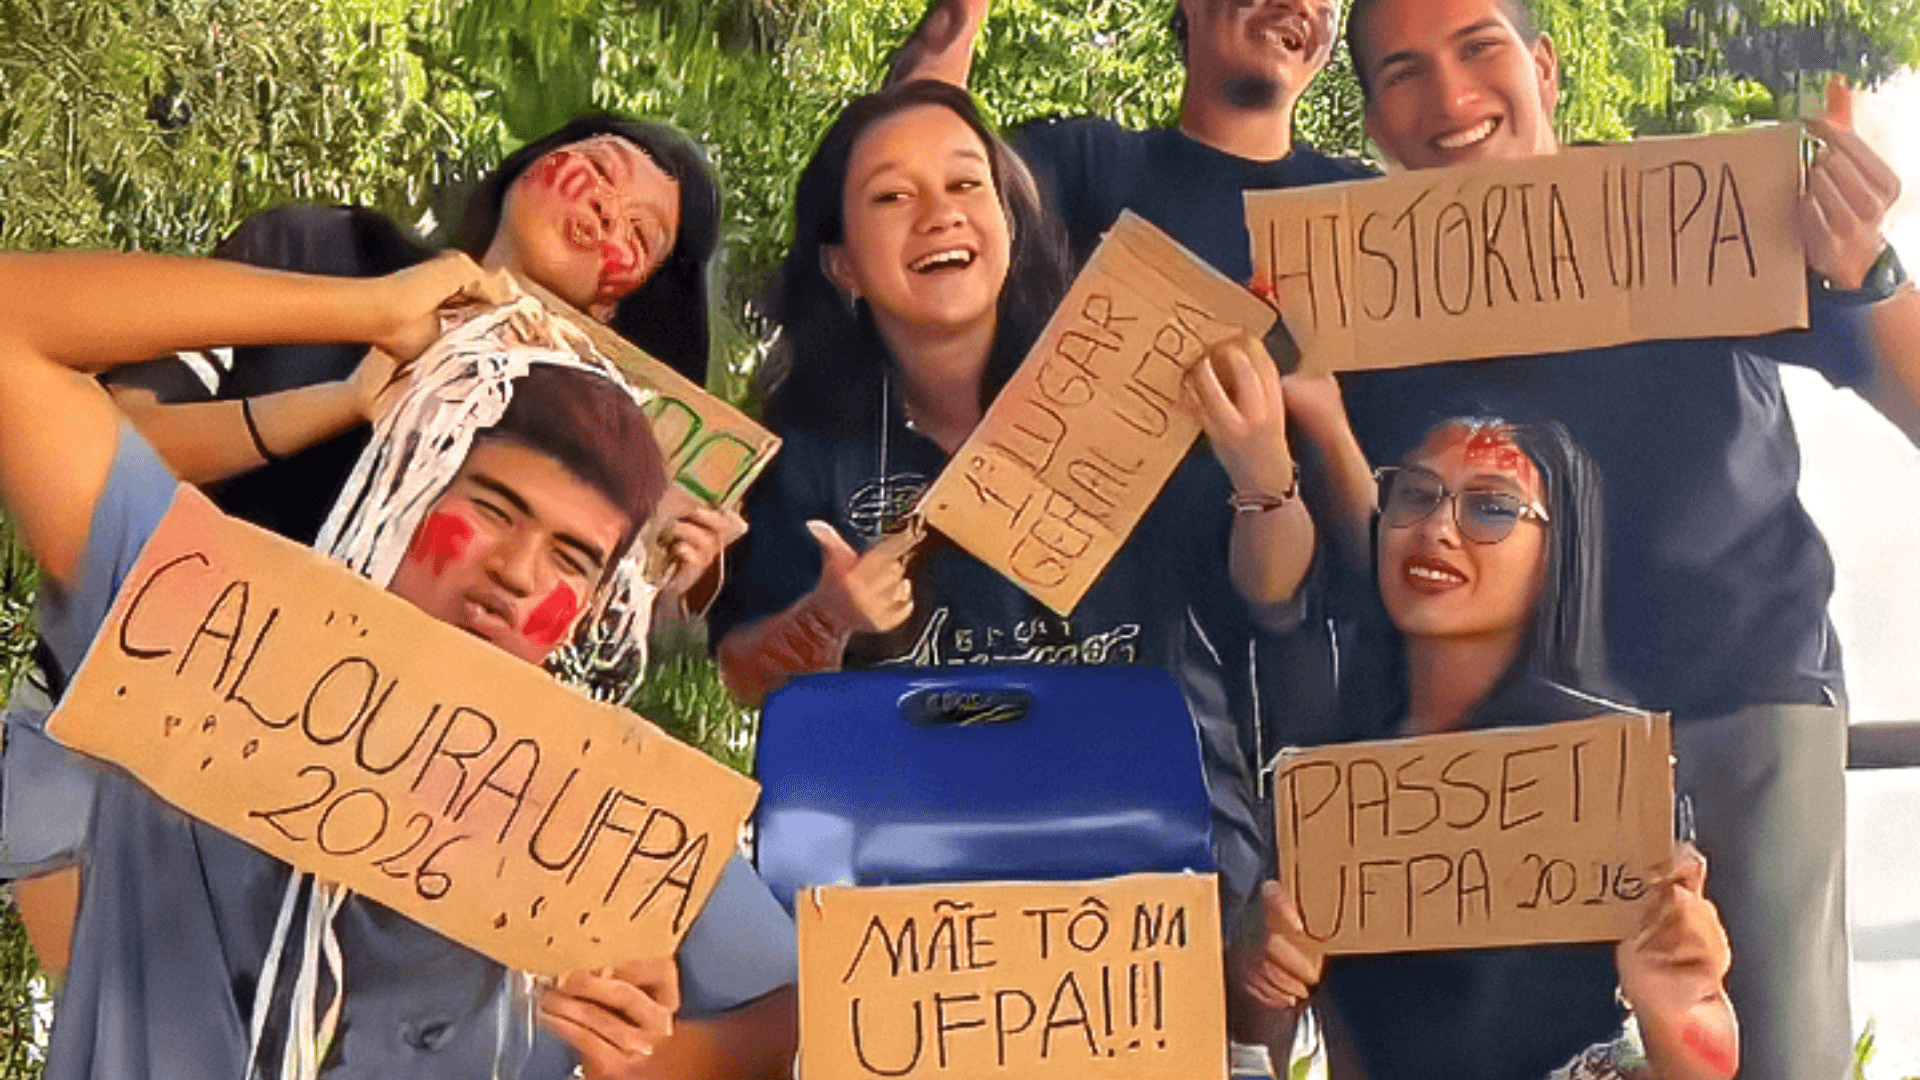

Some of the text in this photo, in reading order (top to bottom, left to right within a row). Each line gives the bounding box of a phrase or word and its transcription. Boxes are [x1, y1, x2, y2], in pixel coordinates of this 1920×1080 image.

[1268, 160, 1759, 329] HISTÓRIA UFPA
[988, 292, 1139, 480] LUGAR
[1008, 446, 1144, 588] GERAL
[1111, 300, 1216, 438] UFPA
[118, 551, 711, 935] CALOURA UFPA
[248, 763, 472, 901] 2026
[1294, 848, 1492, 942] UFPA
[841, 895, 1188, 984] MÃE TÔ NA
[850, 959, 1168, 1077] UFPA!!!
